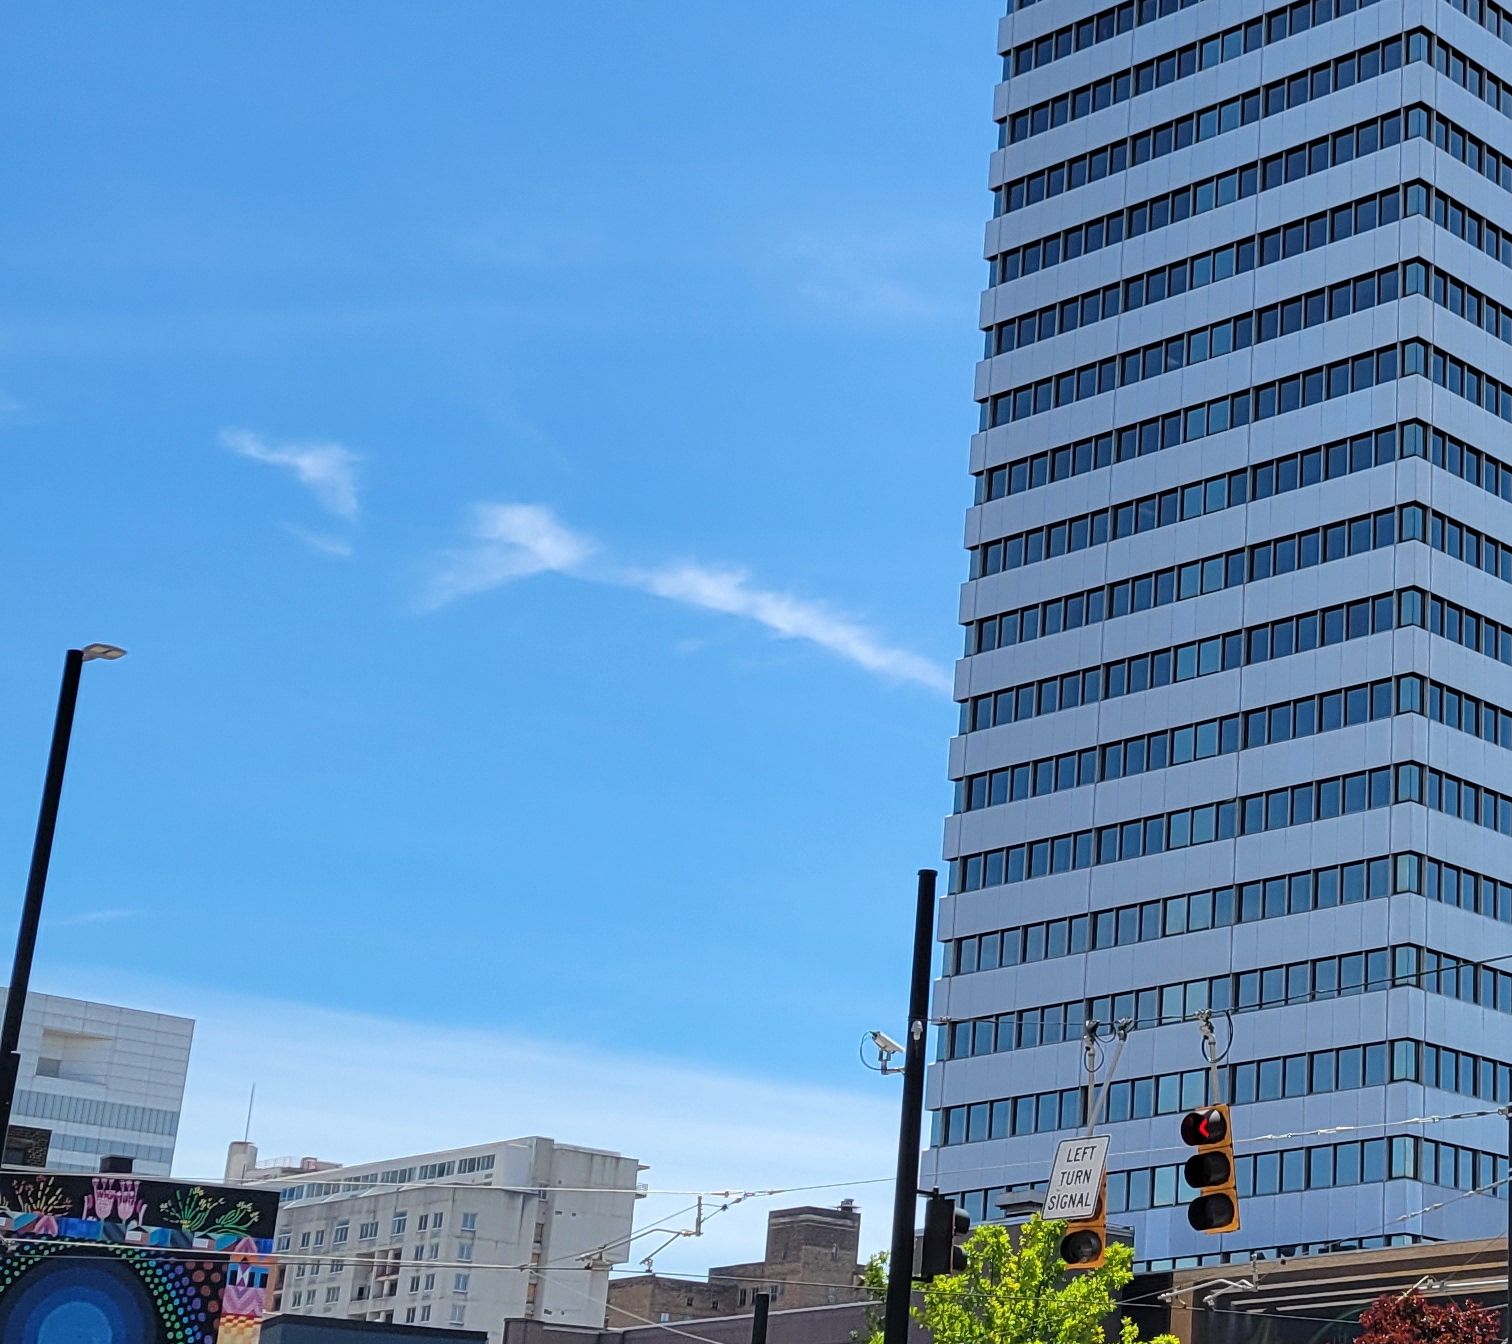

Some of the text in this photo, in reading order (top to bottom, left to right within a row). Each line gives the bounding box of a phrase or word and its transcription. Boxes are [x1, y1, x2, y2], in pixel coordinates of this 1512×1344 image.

[1066, 1145, 1097, 1163] LEFT
[1060, 1169, 1092, 1186] TURN
[1047, 1192, 1091, 1210] SIGNAL
